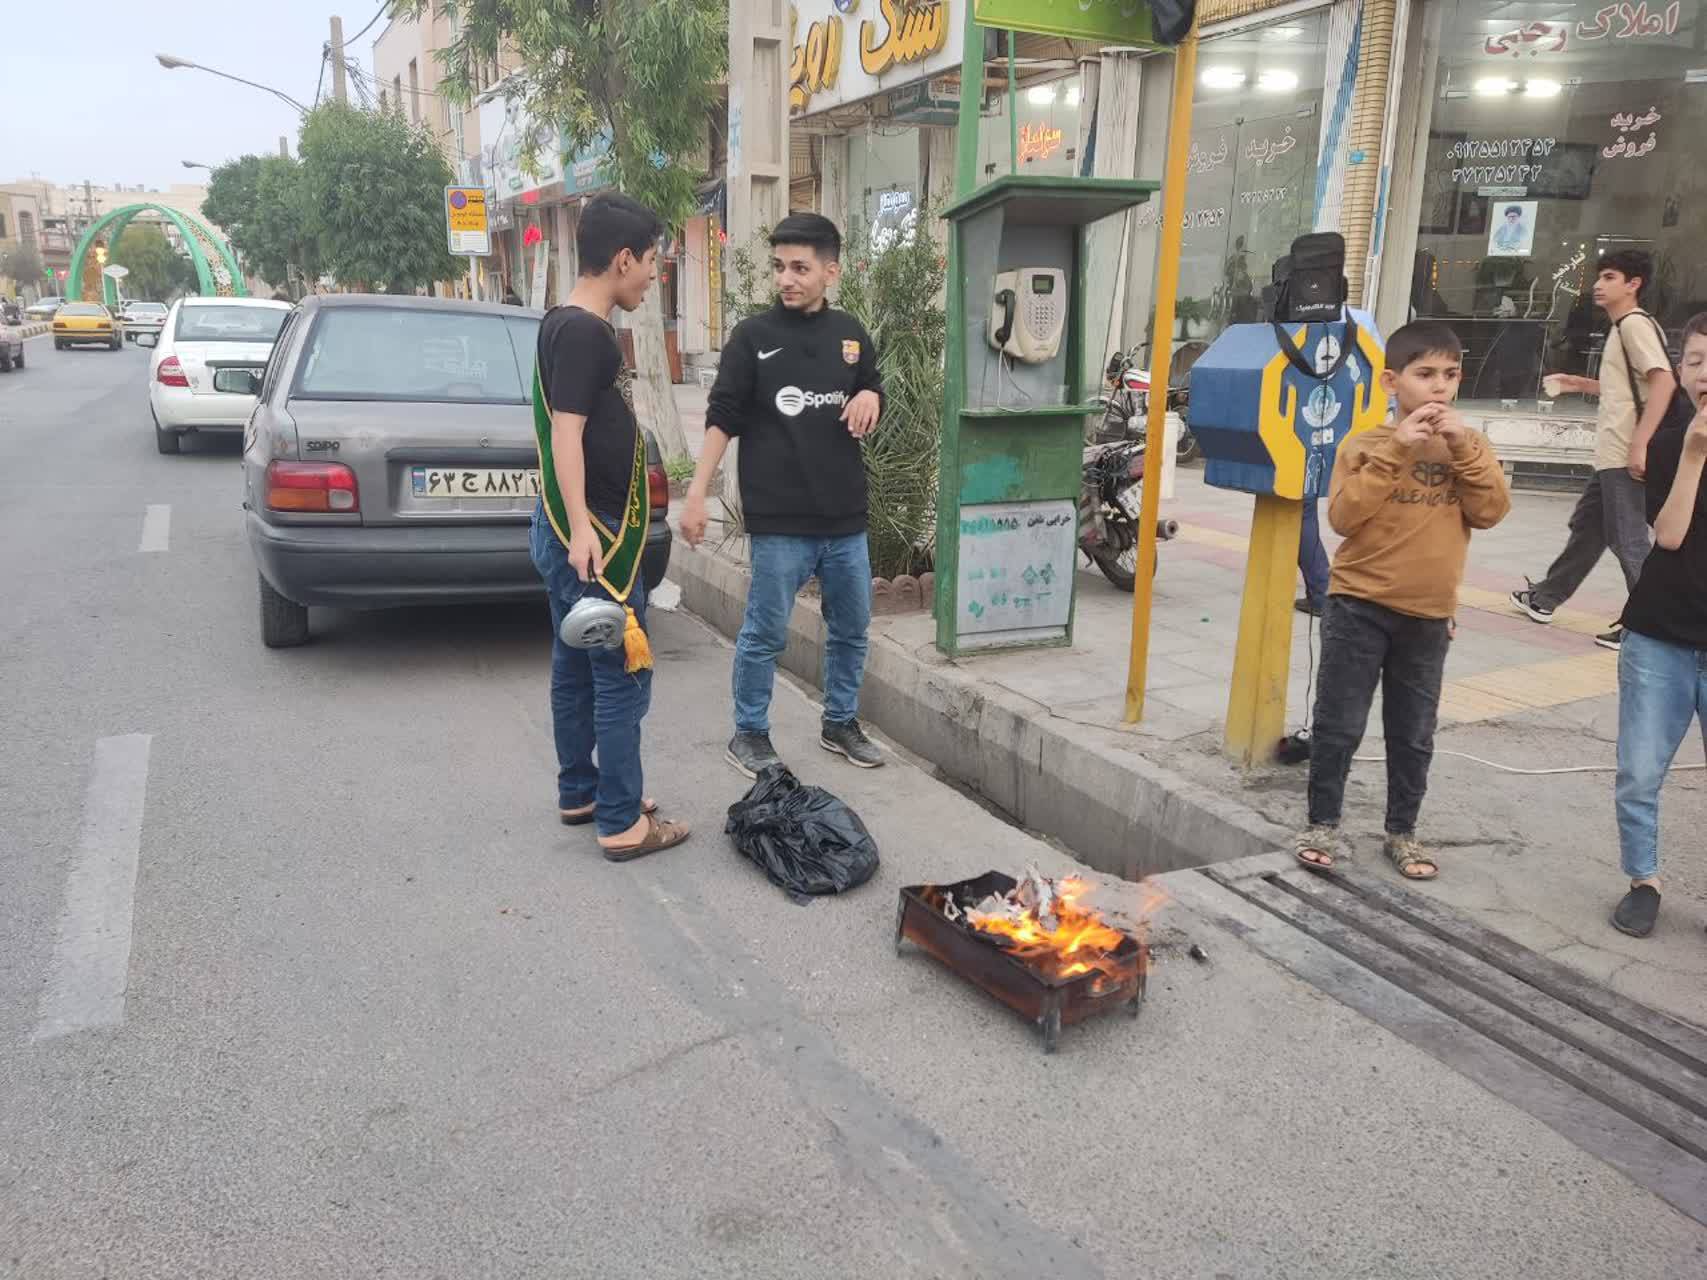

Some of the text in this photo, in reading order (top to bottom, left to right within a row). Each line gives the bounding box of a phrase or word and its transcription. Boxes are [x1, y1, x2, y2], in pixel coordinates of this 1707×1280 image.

[1576, 1, 1680, 40] املاک
[1611, 106, 1662, 132] خرید
[1246, 126, 1297, 167] خرید
[1603, 132, 1656, 158] فروش
